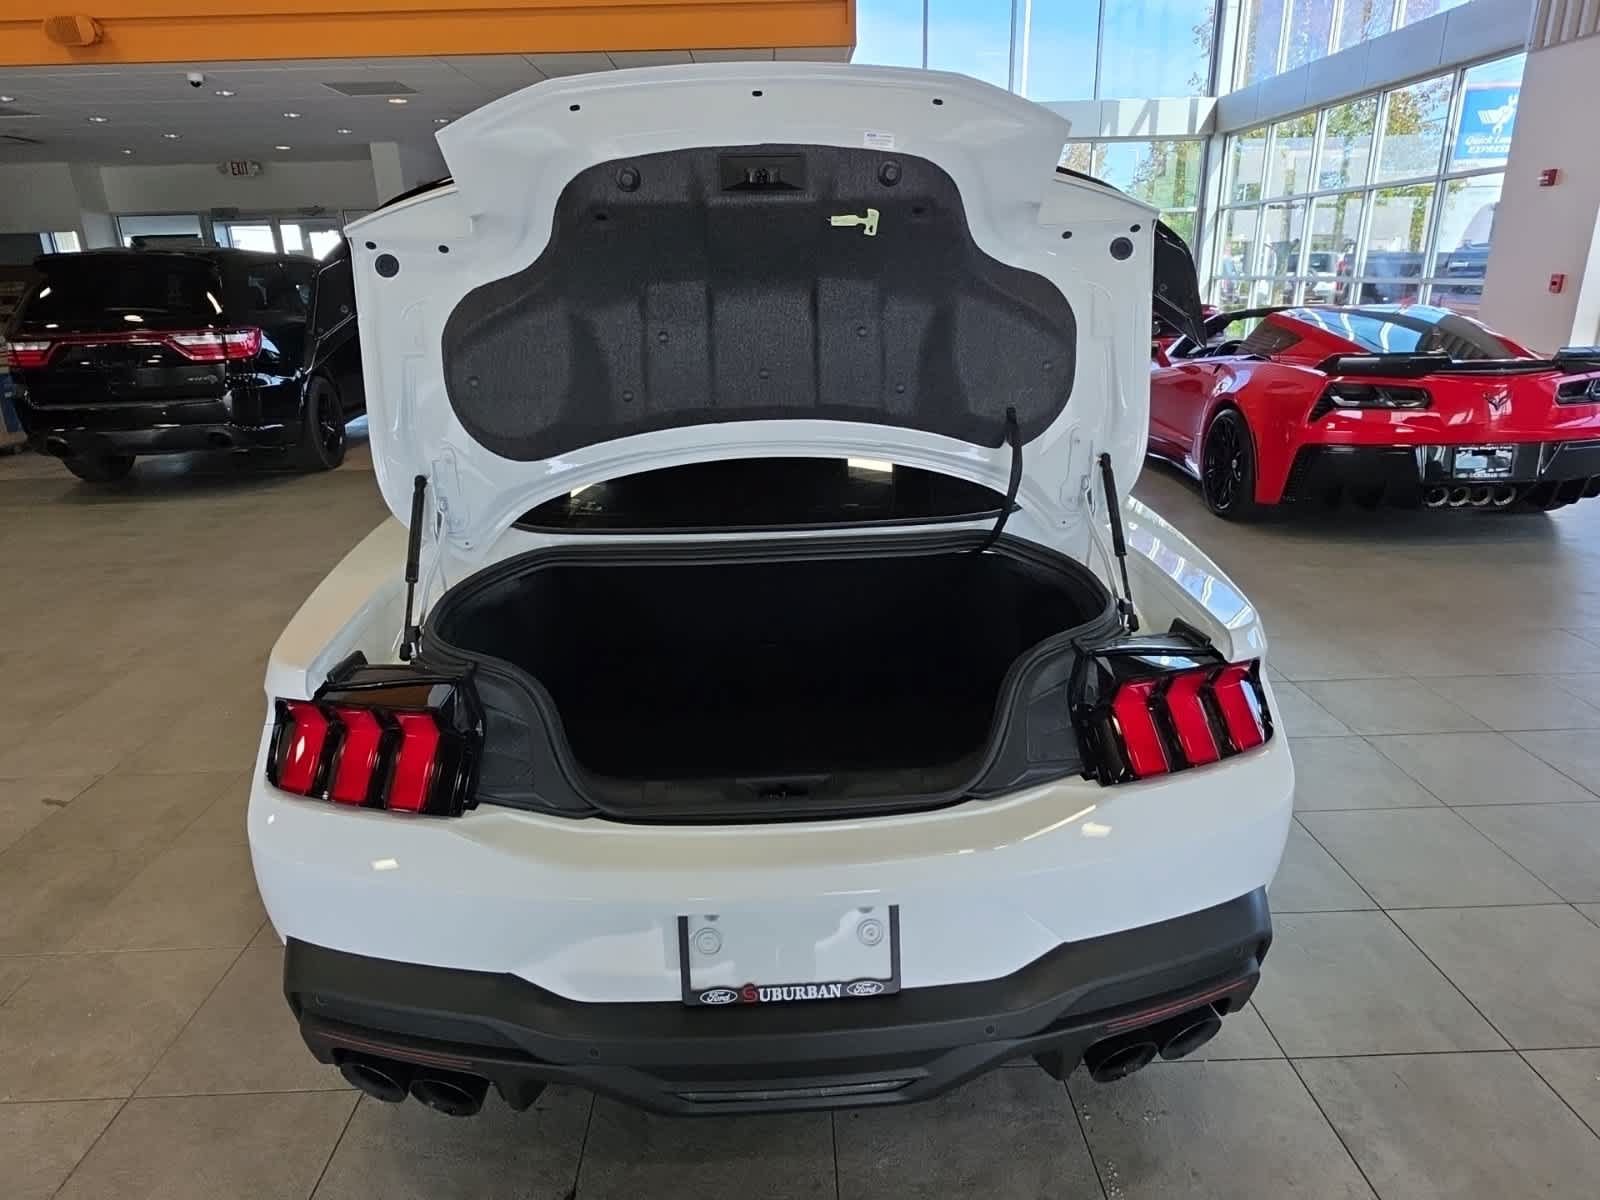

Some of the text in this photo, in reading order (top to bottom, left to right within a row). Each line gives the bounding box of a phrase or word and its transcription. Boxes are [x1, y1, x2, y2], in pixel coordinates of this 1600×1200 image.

[230, 161, 249, 176] EXIT
[704, 982, 880, 1003] Ford SUBURBAN Ford
